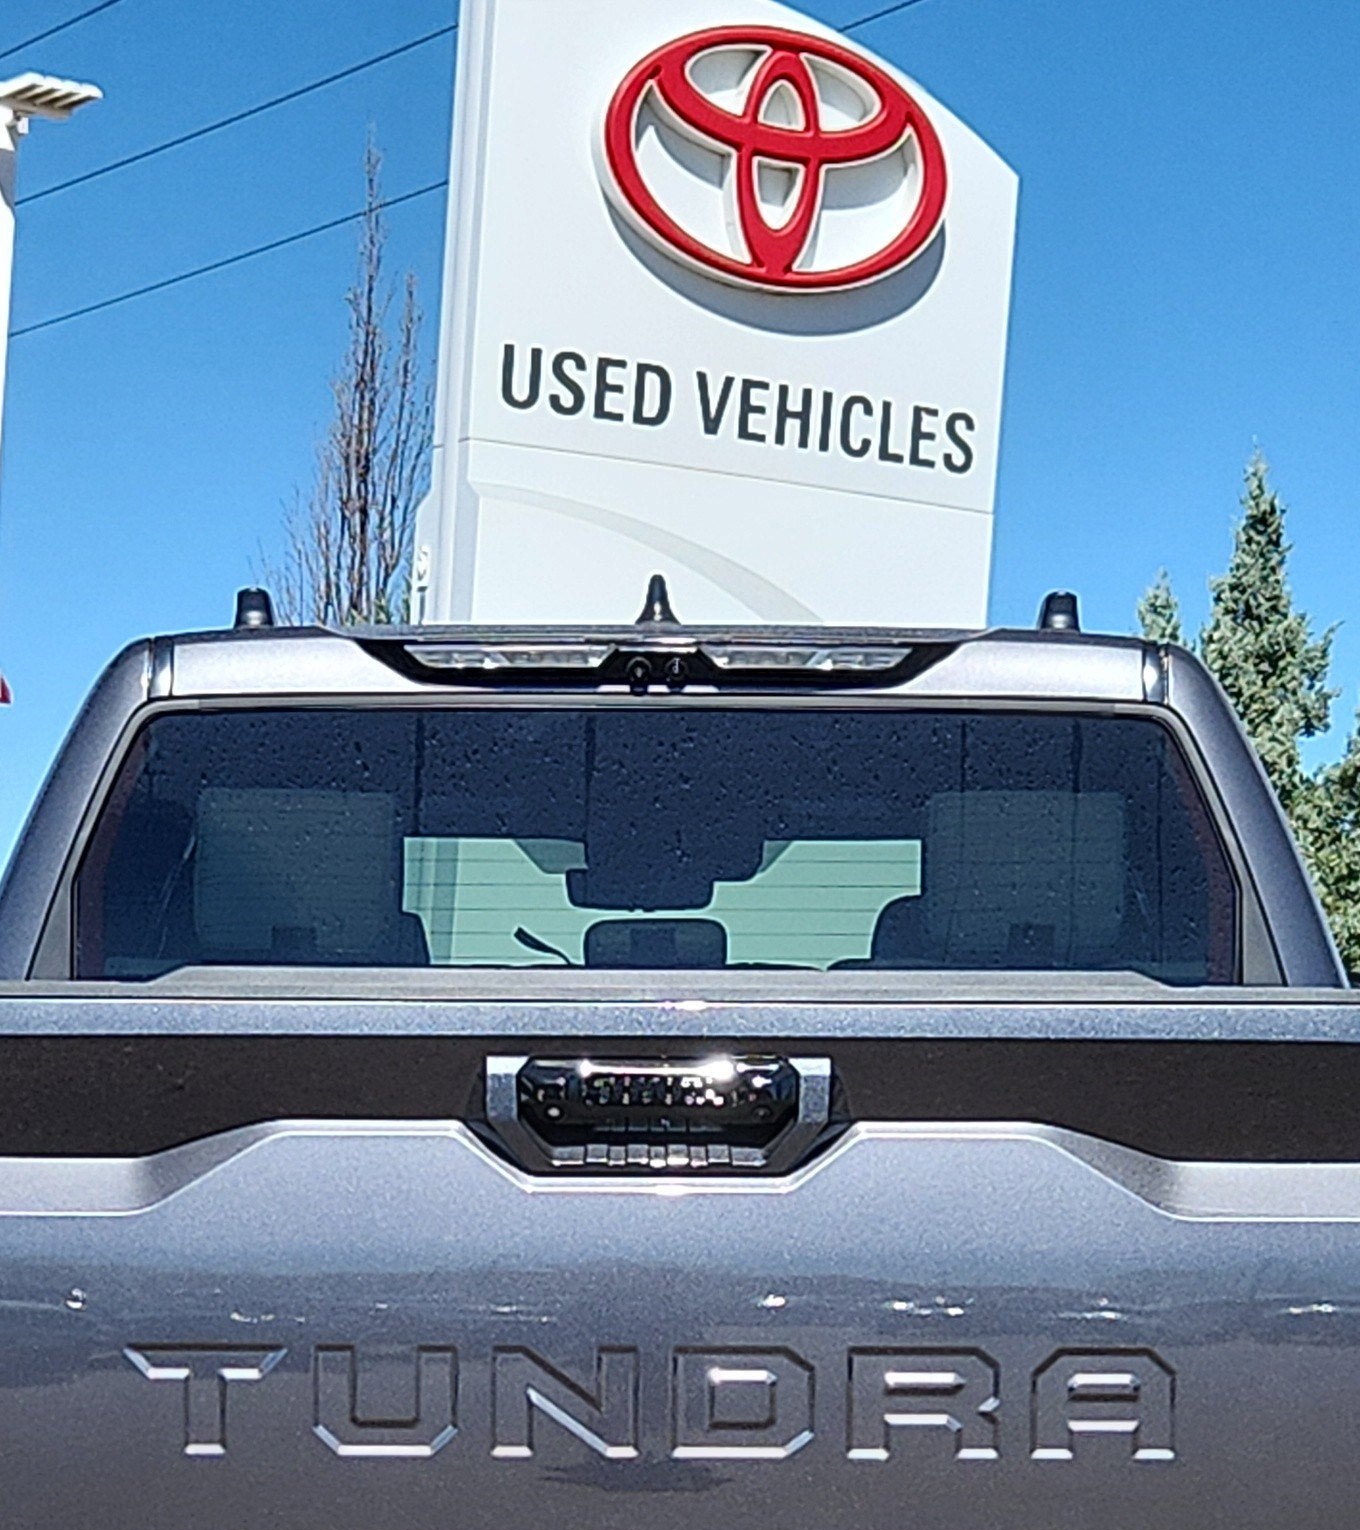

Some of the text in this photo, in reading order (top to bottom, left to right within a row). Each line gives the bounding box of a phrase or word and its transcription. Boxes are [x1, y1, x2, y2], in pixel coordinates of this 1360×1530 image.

[499, 342, 978, 476] USED VEHICLES
[125, 1342, 1177, 1461] TUNDRA
